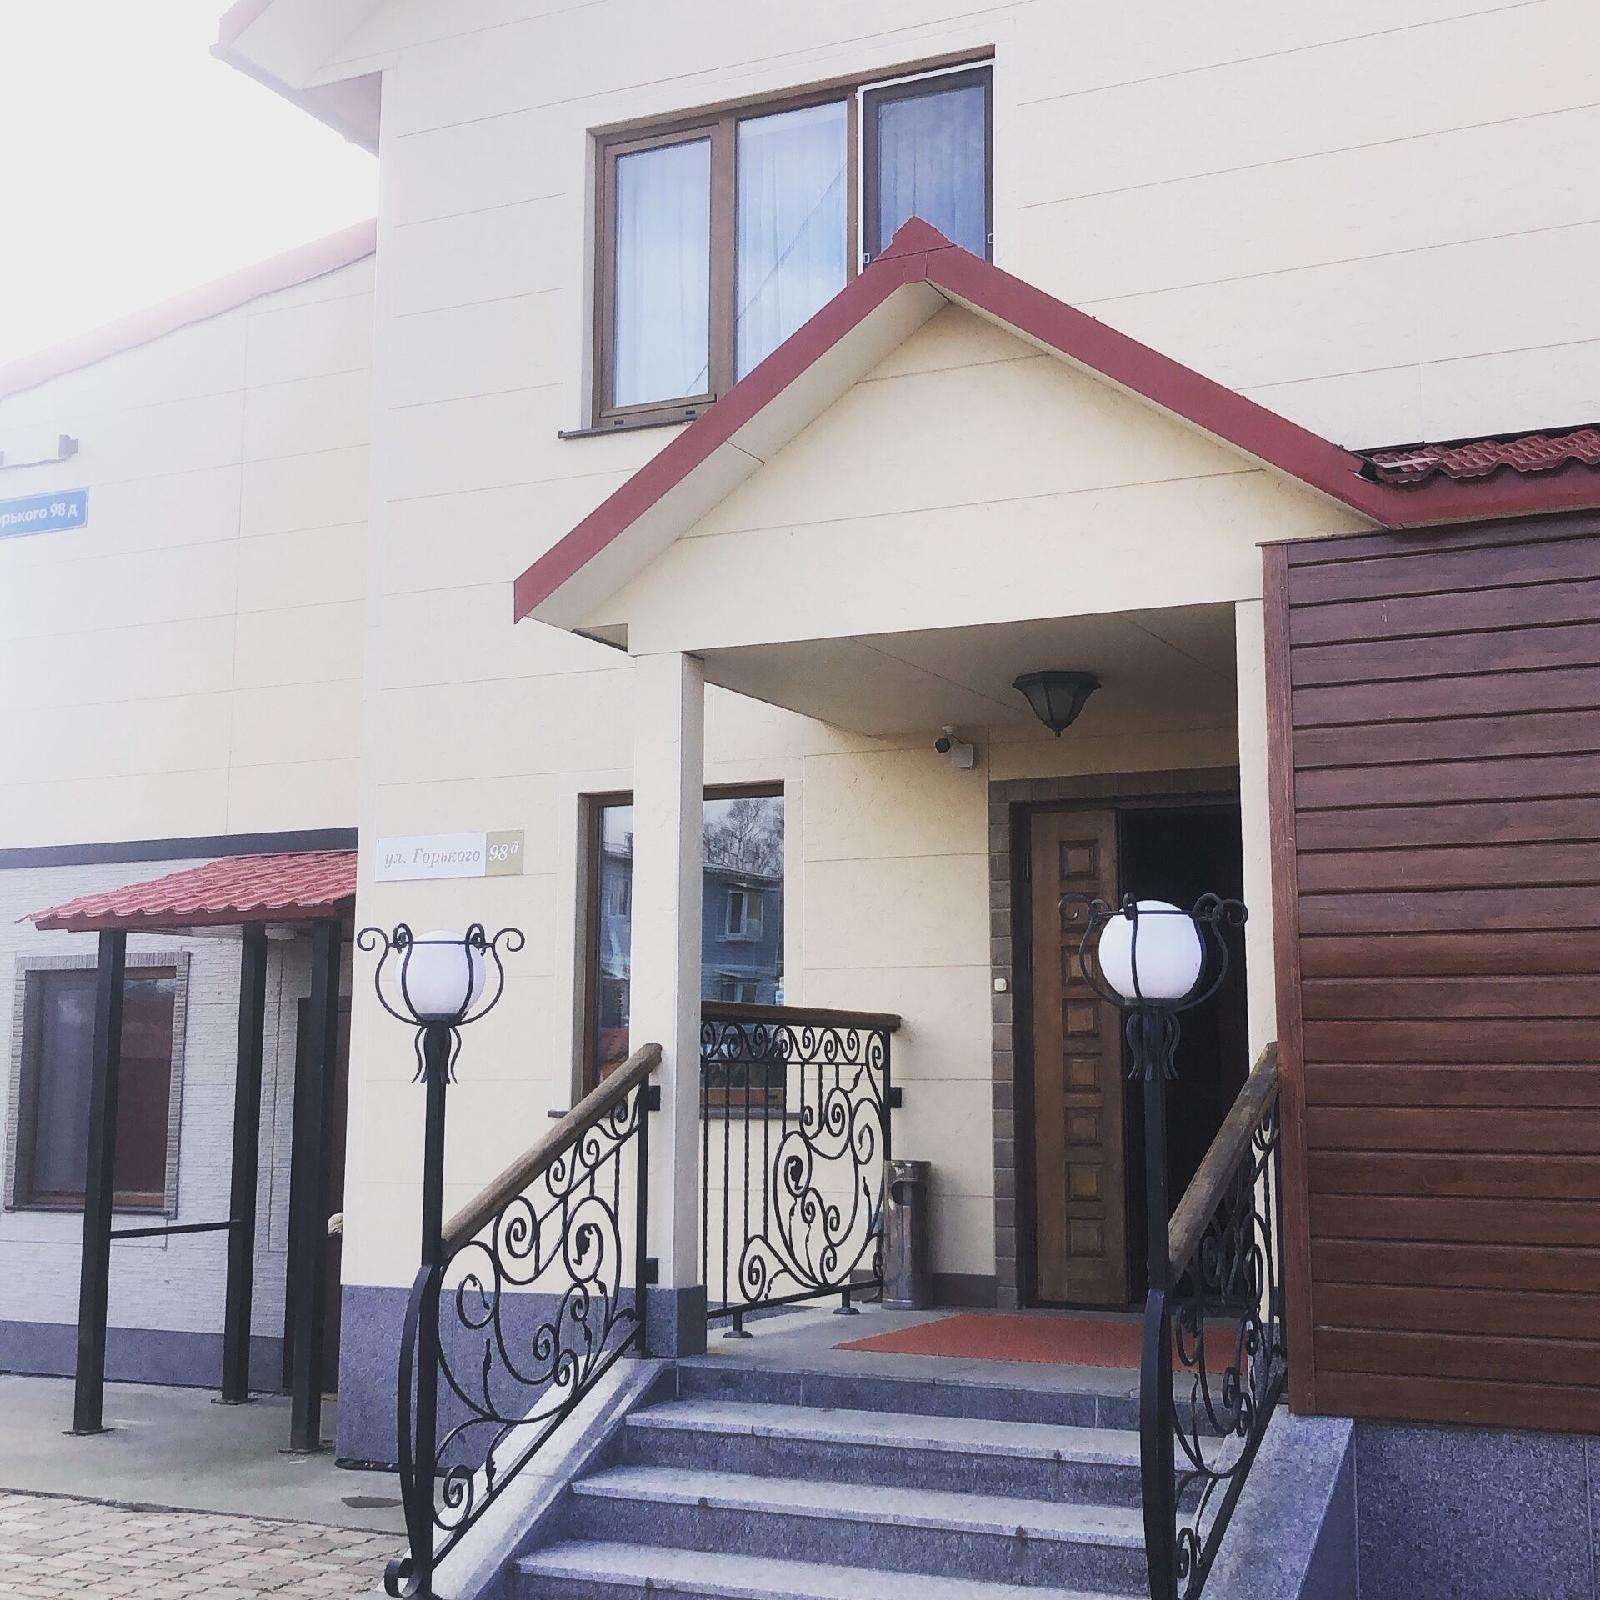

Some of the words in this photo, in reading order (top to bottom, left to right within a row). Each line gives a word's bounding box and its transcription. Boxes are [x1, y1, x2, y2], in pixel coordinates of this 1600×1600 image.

[0, 508, 47, 528] рького
[50, 502, 66, 518] 98
[384, 852, 407, 869] ул.
[413, 847, 481, 868] Горького
